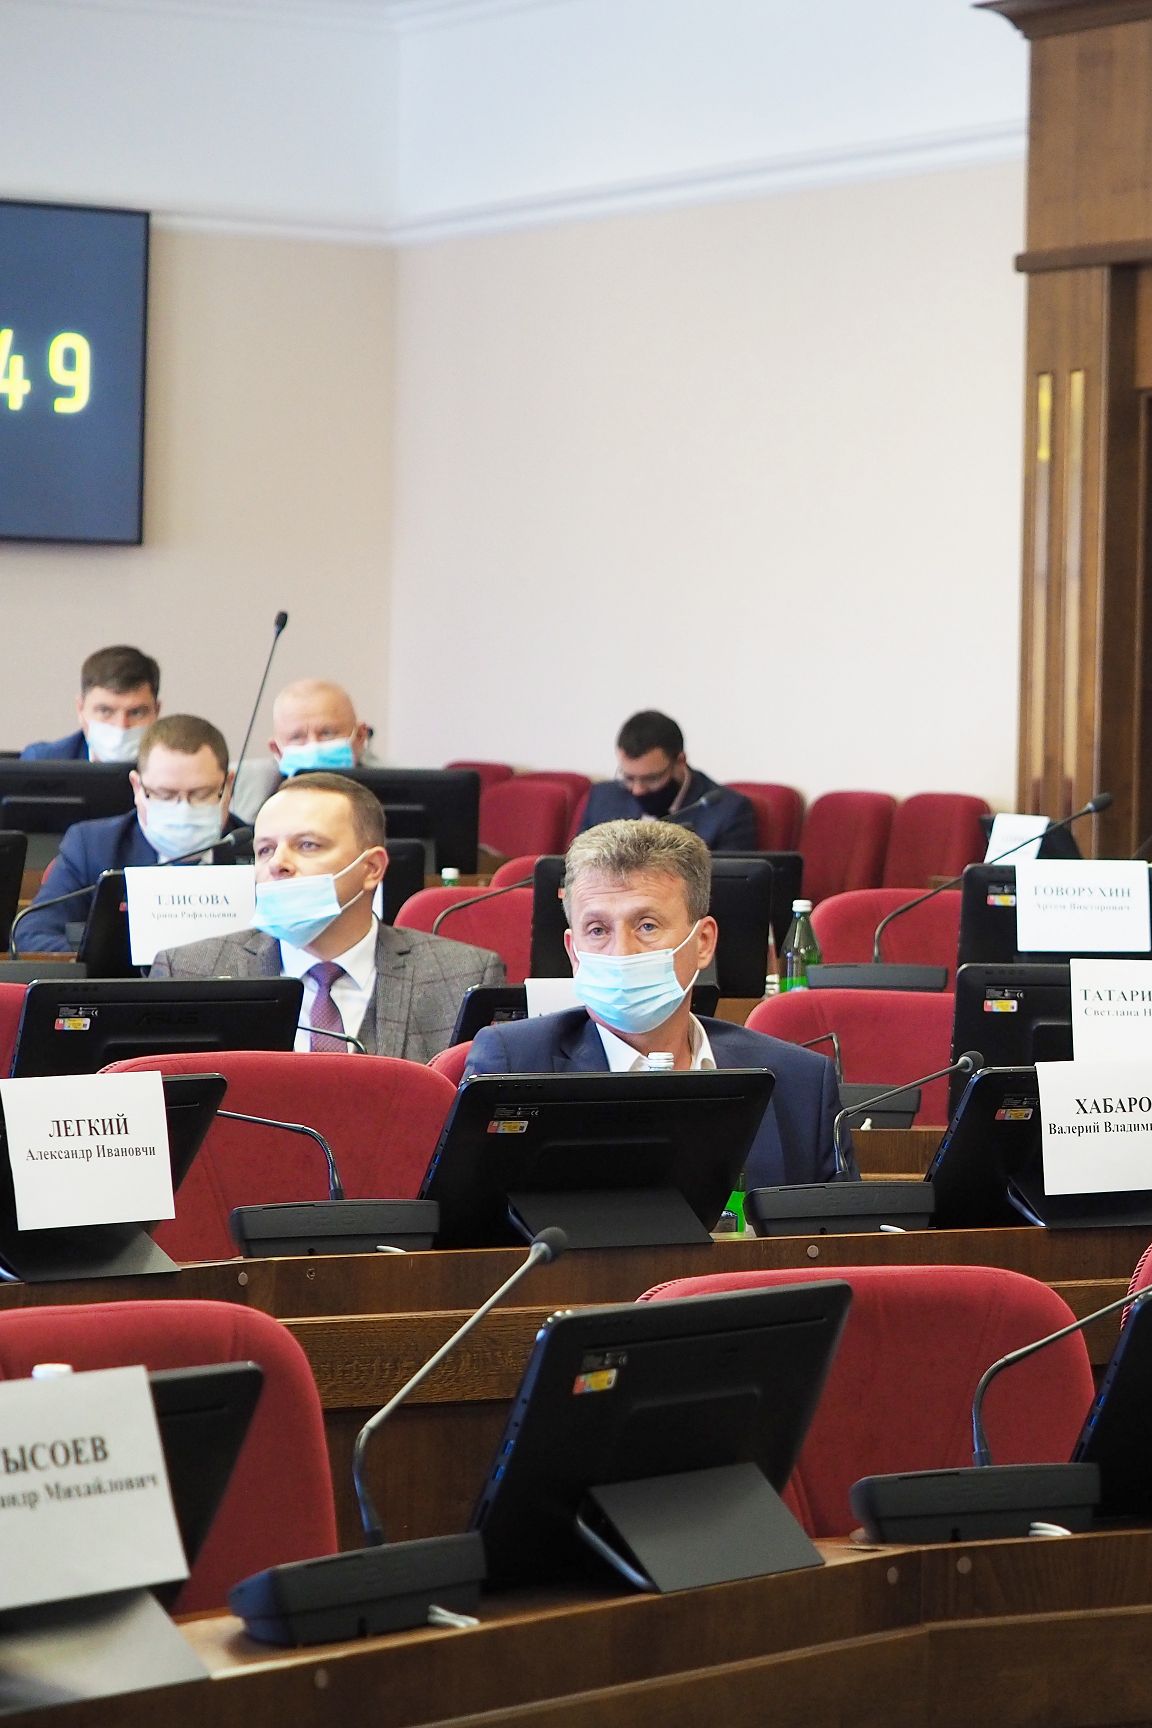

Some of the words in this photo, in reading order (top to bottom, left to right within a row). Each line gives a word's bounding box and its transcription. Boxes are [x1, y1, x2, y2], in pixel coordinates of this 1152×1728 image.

[0, 328, 91, 413] 49
[1033, 885, 1131, 898] ГОВОРУХИН
[1084, 1007, 1140, 1018] Светлана
[48, 1113, 129, 1138] ЛЕГКИЙ
[1049, 1121, 1101, 1137] Валерий
[26, 1147, 94, 1162] Александр
[96, 1144, 157, 1158] Ивановчи
[0, 1435, 110, 1475] ЫСОЕВ
[44, 1473, 158, 1501] Михайлович
